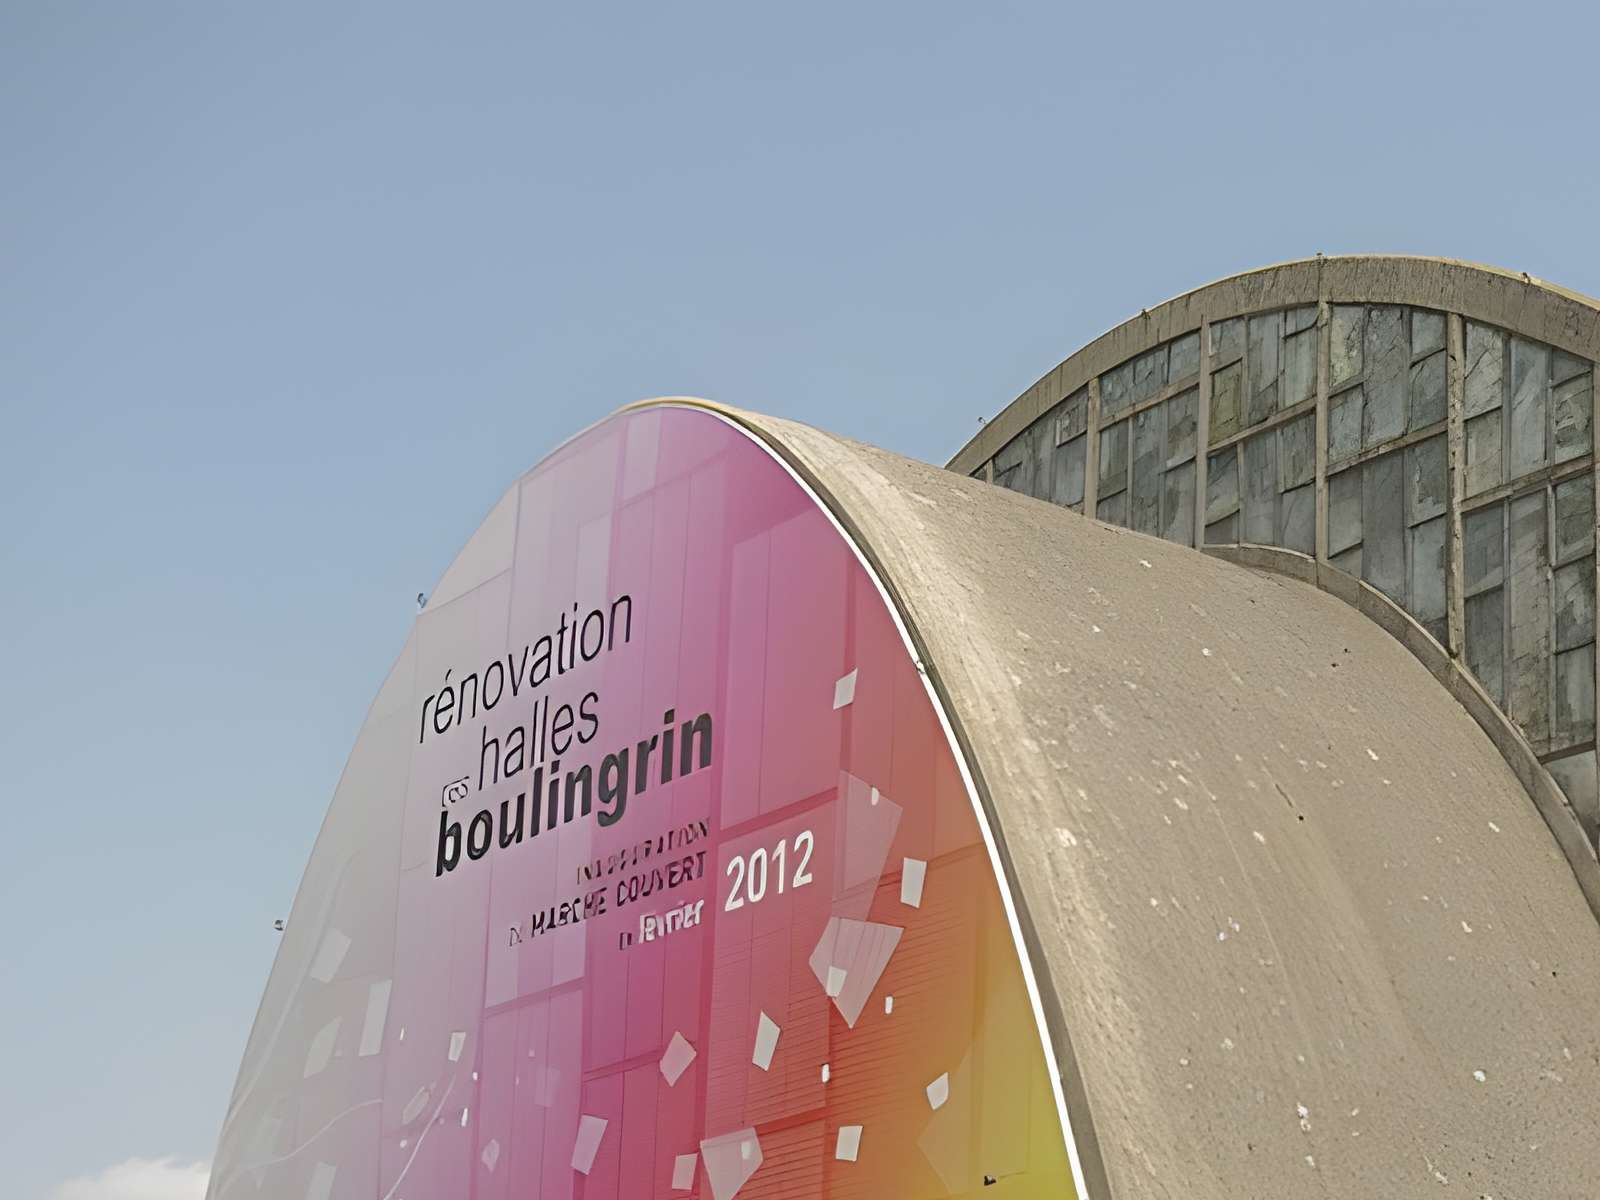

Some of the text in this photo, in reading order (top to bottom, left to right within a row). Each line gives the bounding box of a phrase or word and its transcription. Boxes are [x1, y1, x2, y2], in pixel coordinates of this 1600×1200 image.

[419, 594, 632, 744] rénovation
[478, 692, 599, 790] halles
[436, 708, 713, 877] boulingrin
[616, 850, 708, 907] COUVERT
[723, 830, 815, 912] 2012
